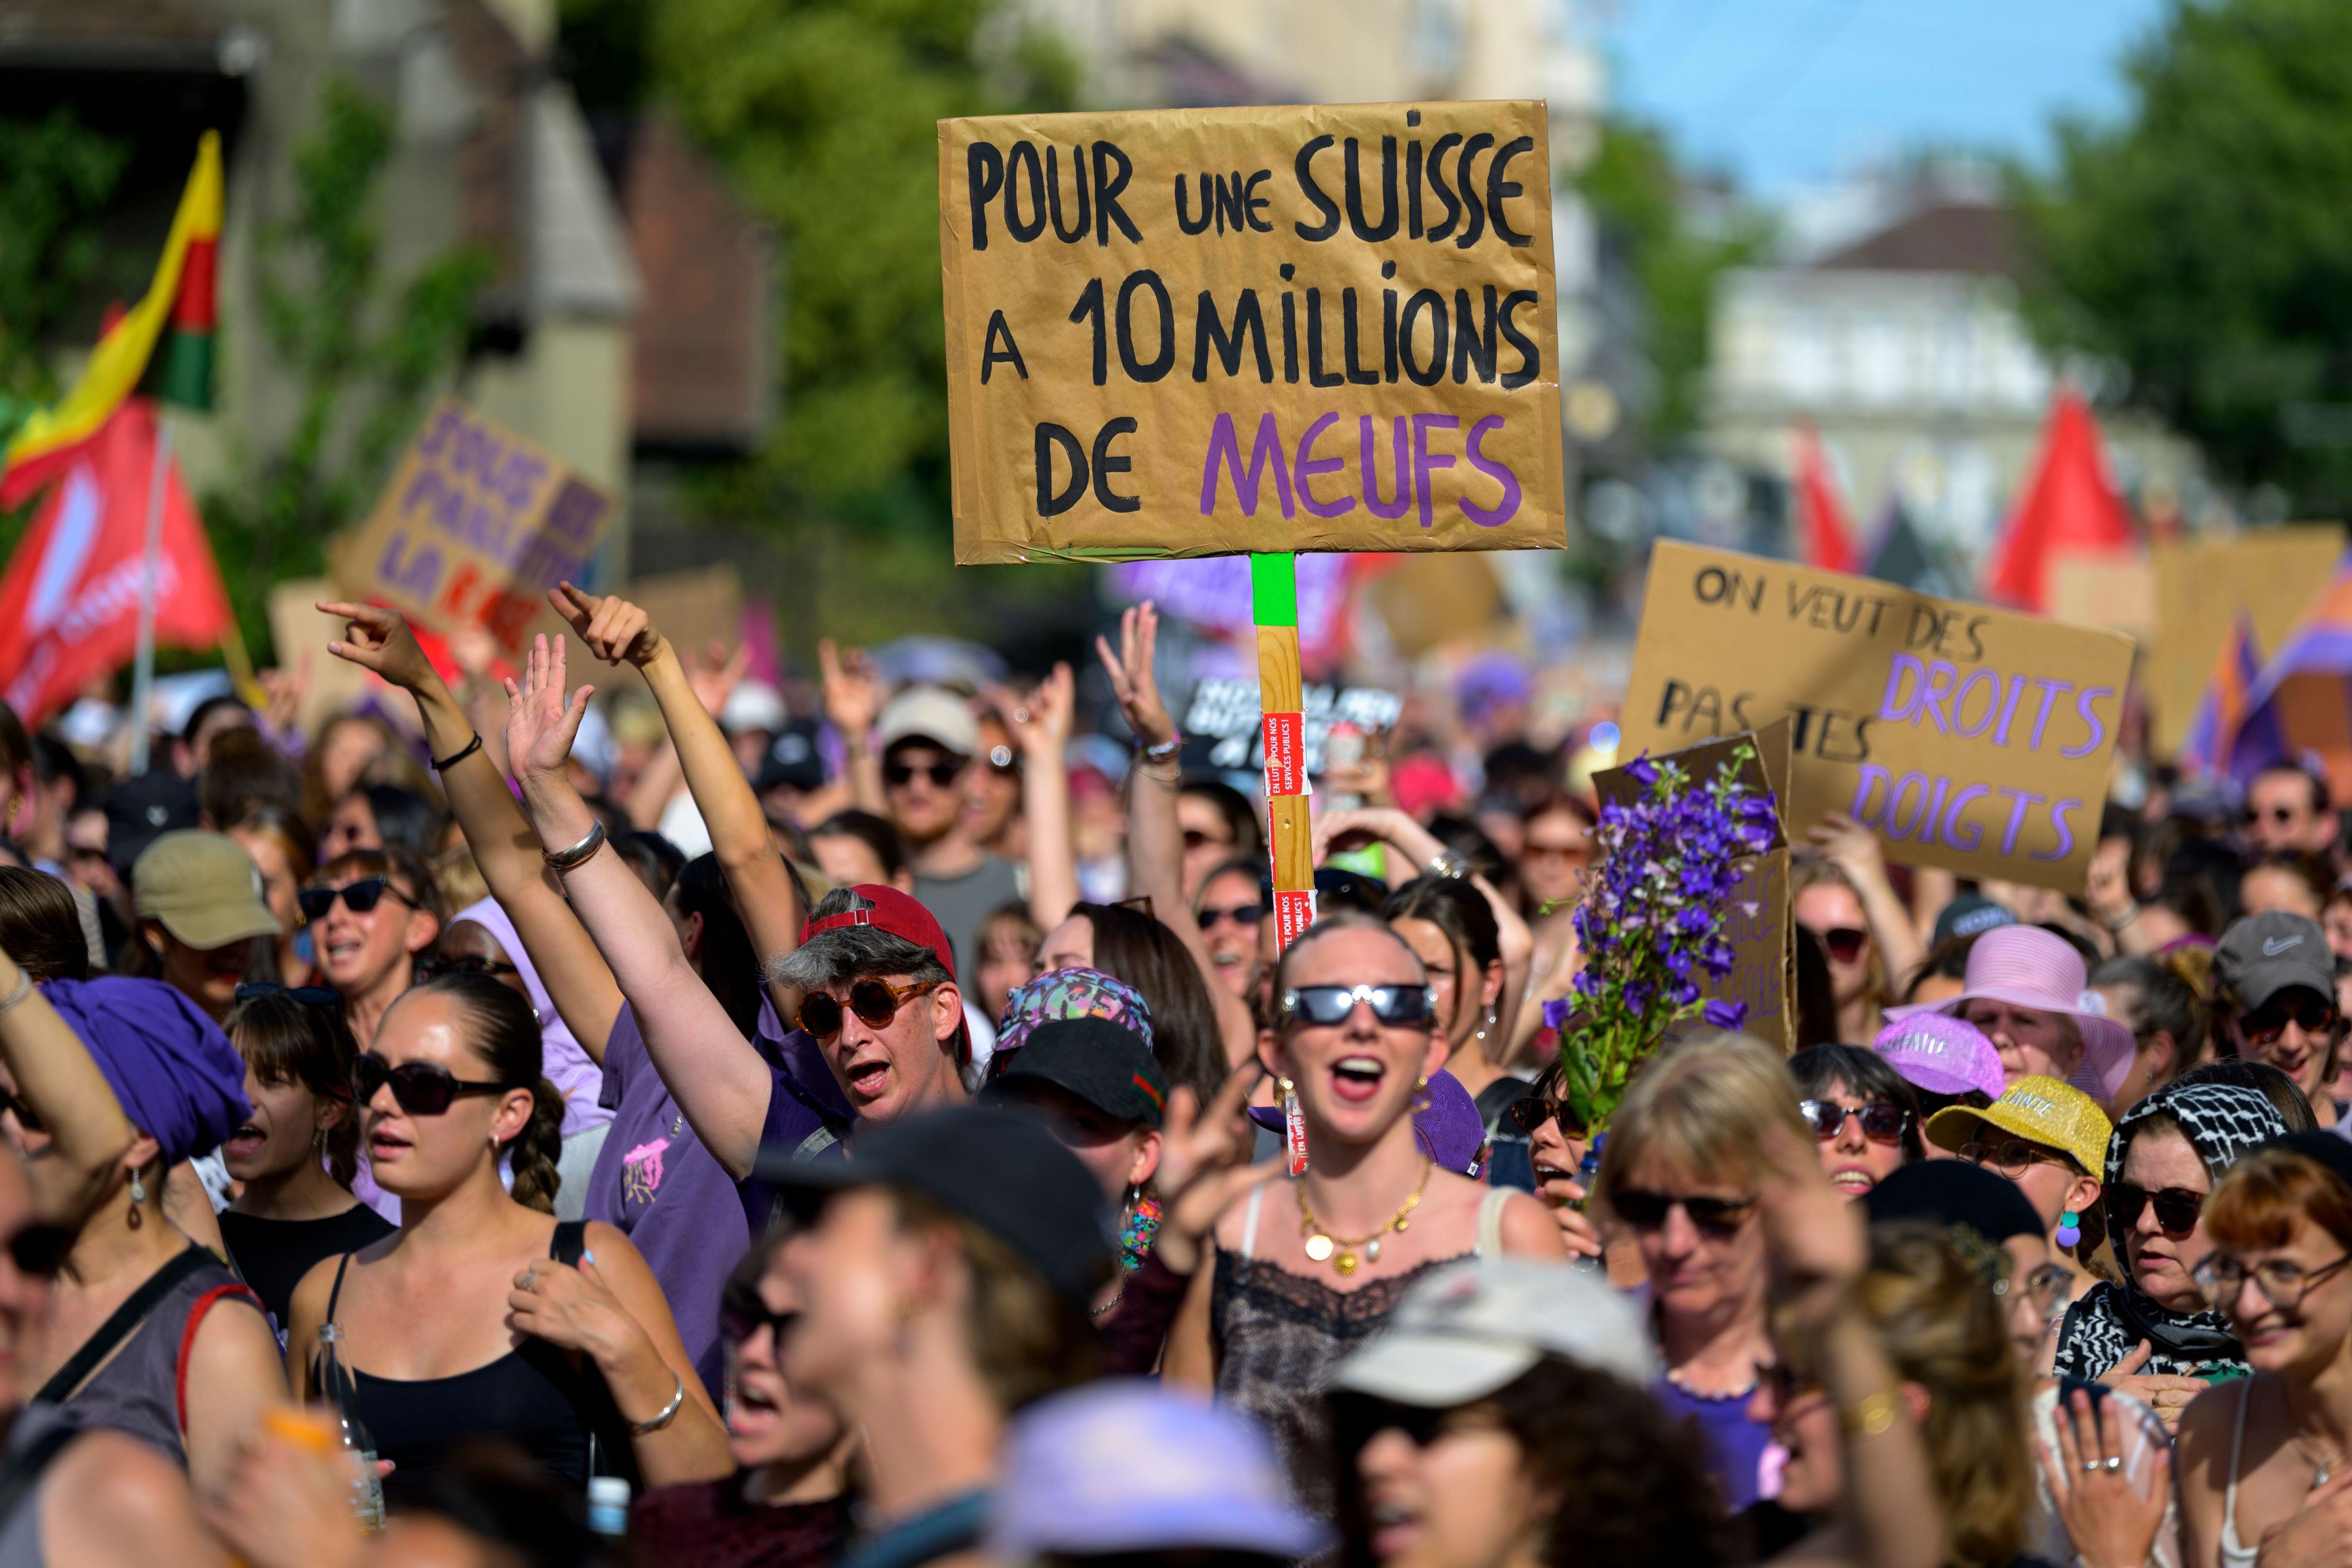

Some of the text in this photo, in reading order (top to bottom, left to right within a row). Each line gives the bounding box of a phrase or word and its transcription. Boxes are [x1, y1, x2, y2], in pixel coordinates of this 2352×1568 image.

[968, 110, 1534, 251] POUR UNE SUISSE
[980, 260, 1541, 390] A 10 MILLIONS
[1034, 412, 1522, 528] DE MEUFS
[1695, 566, 1990, 663] ON VEUT DES
[1658, 679, 1879, 763] PAS TES
[1878, 651, 2115, 758] DROITS
[1271, 758, 1279, 782] LUTTE
[1273, 783, 1279, 794] EN
[1284, 755, 1292, 790] SERVICES
[1851, 763, 2084, 863] DOIGTS
[1283, 914, 1291, 935] POUR
